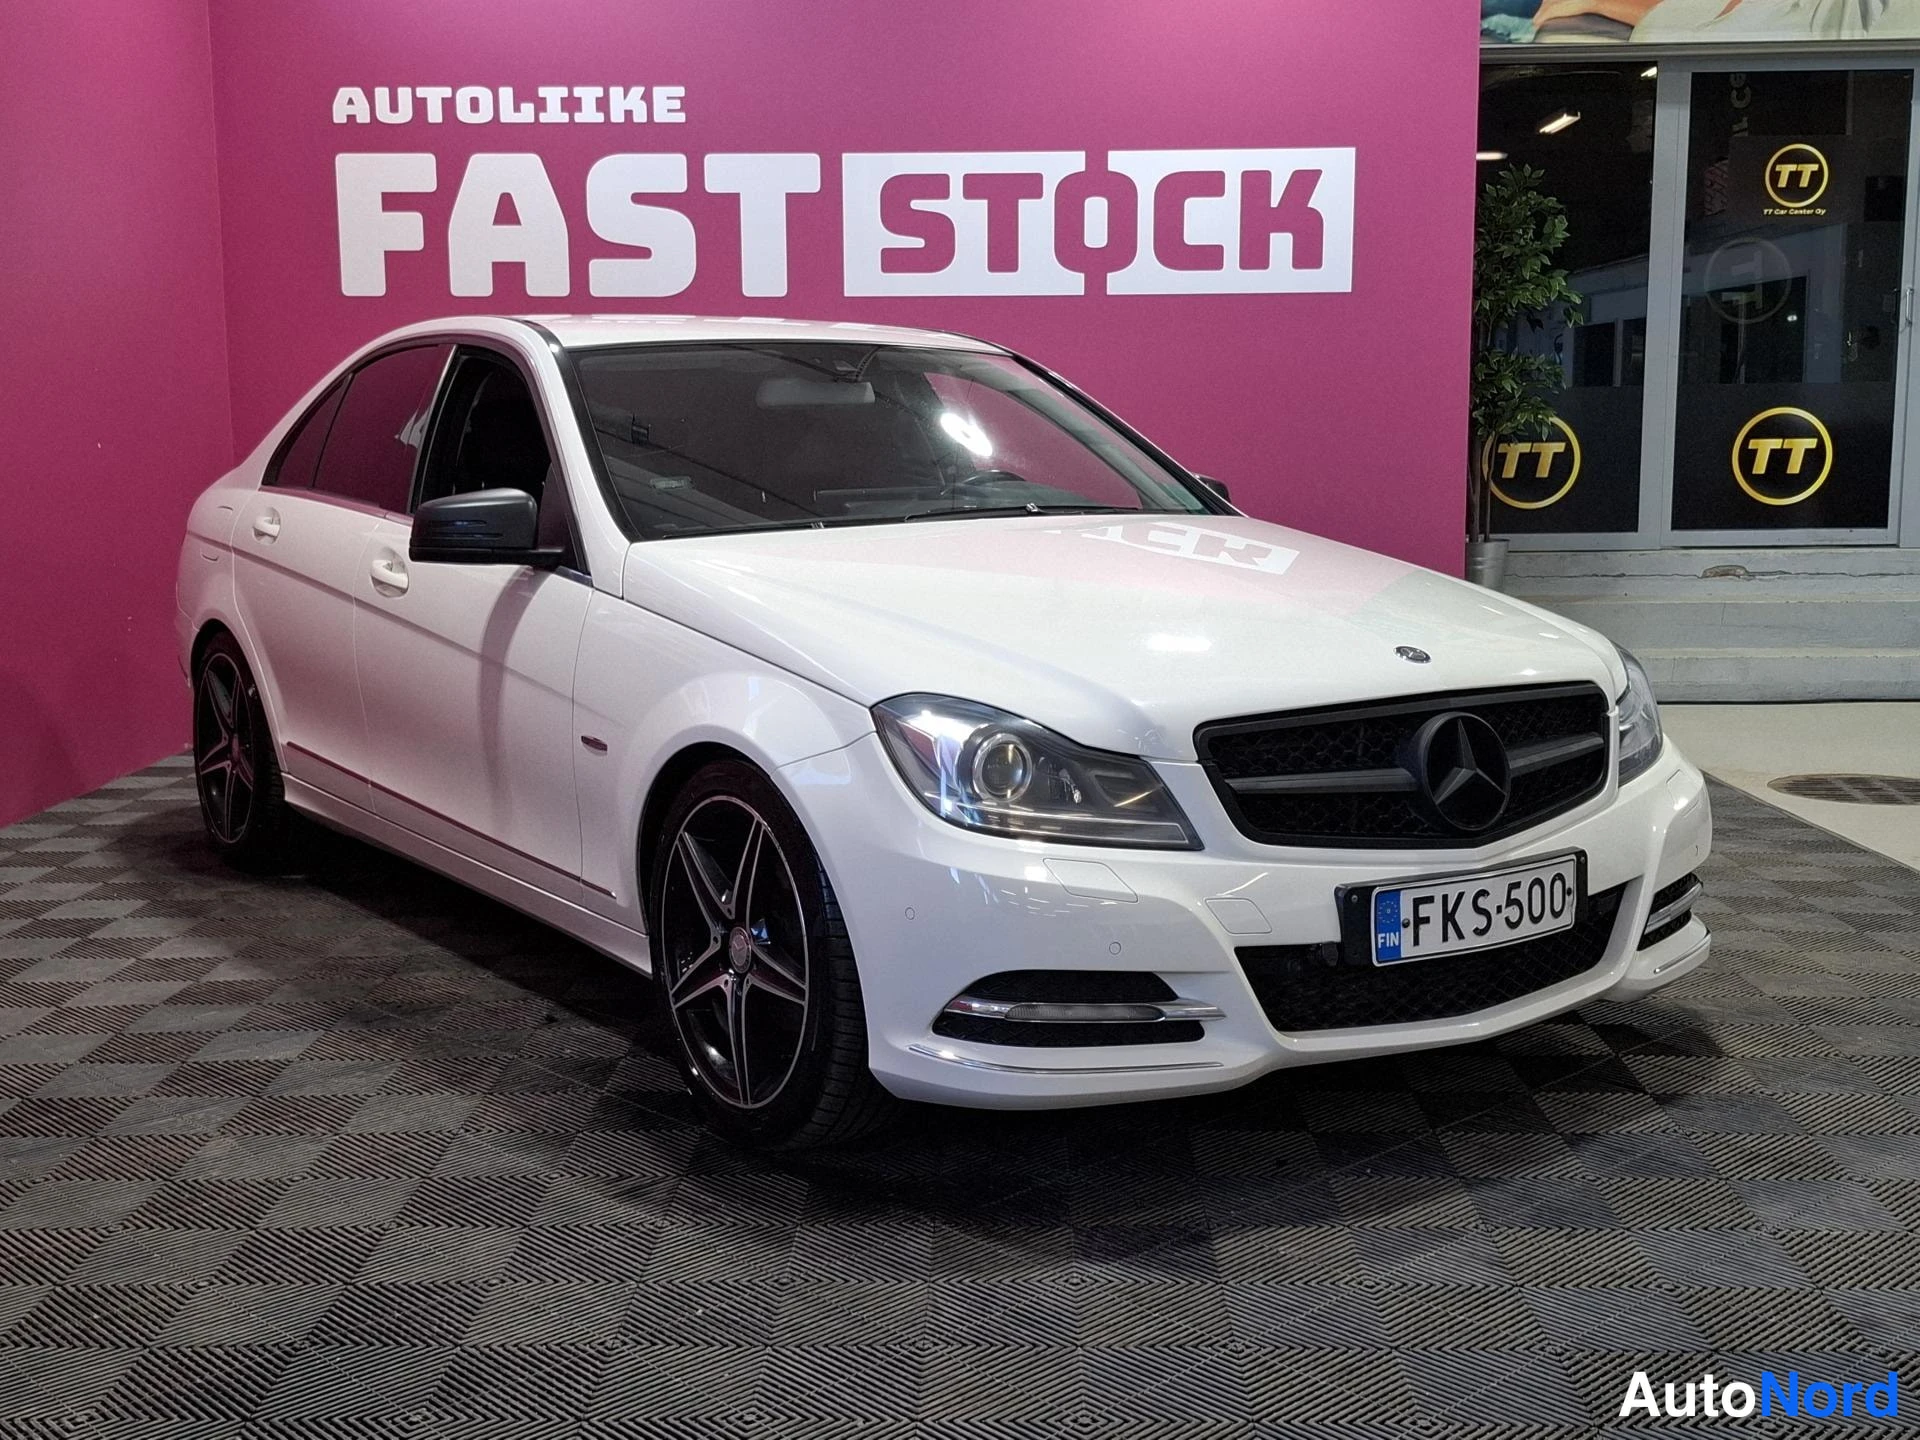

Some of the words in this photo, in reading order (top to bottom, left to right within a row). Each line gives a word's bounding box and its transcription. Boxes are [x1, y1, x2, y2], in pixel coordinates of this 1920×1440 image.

[332, 86, 686, 124] AUTOLIIKE
[1775, 163, 1819, 188] TT
[335, 153, 821, 298] FAST
[879, 168, 1325, 274] STOCK
[1814, 208, 1827, 216] Oy
[1498, 442, 1566, 478] TT
[1748, 438, 1818, 474] TT
[1412, 872, 1567, 947] FKS-500
[1377, 931, 1400, 949] FIN
